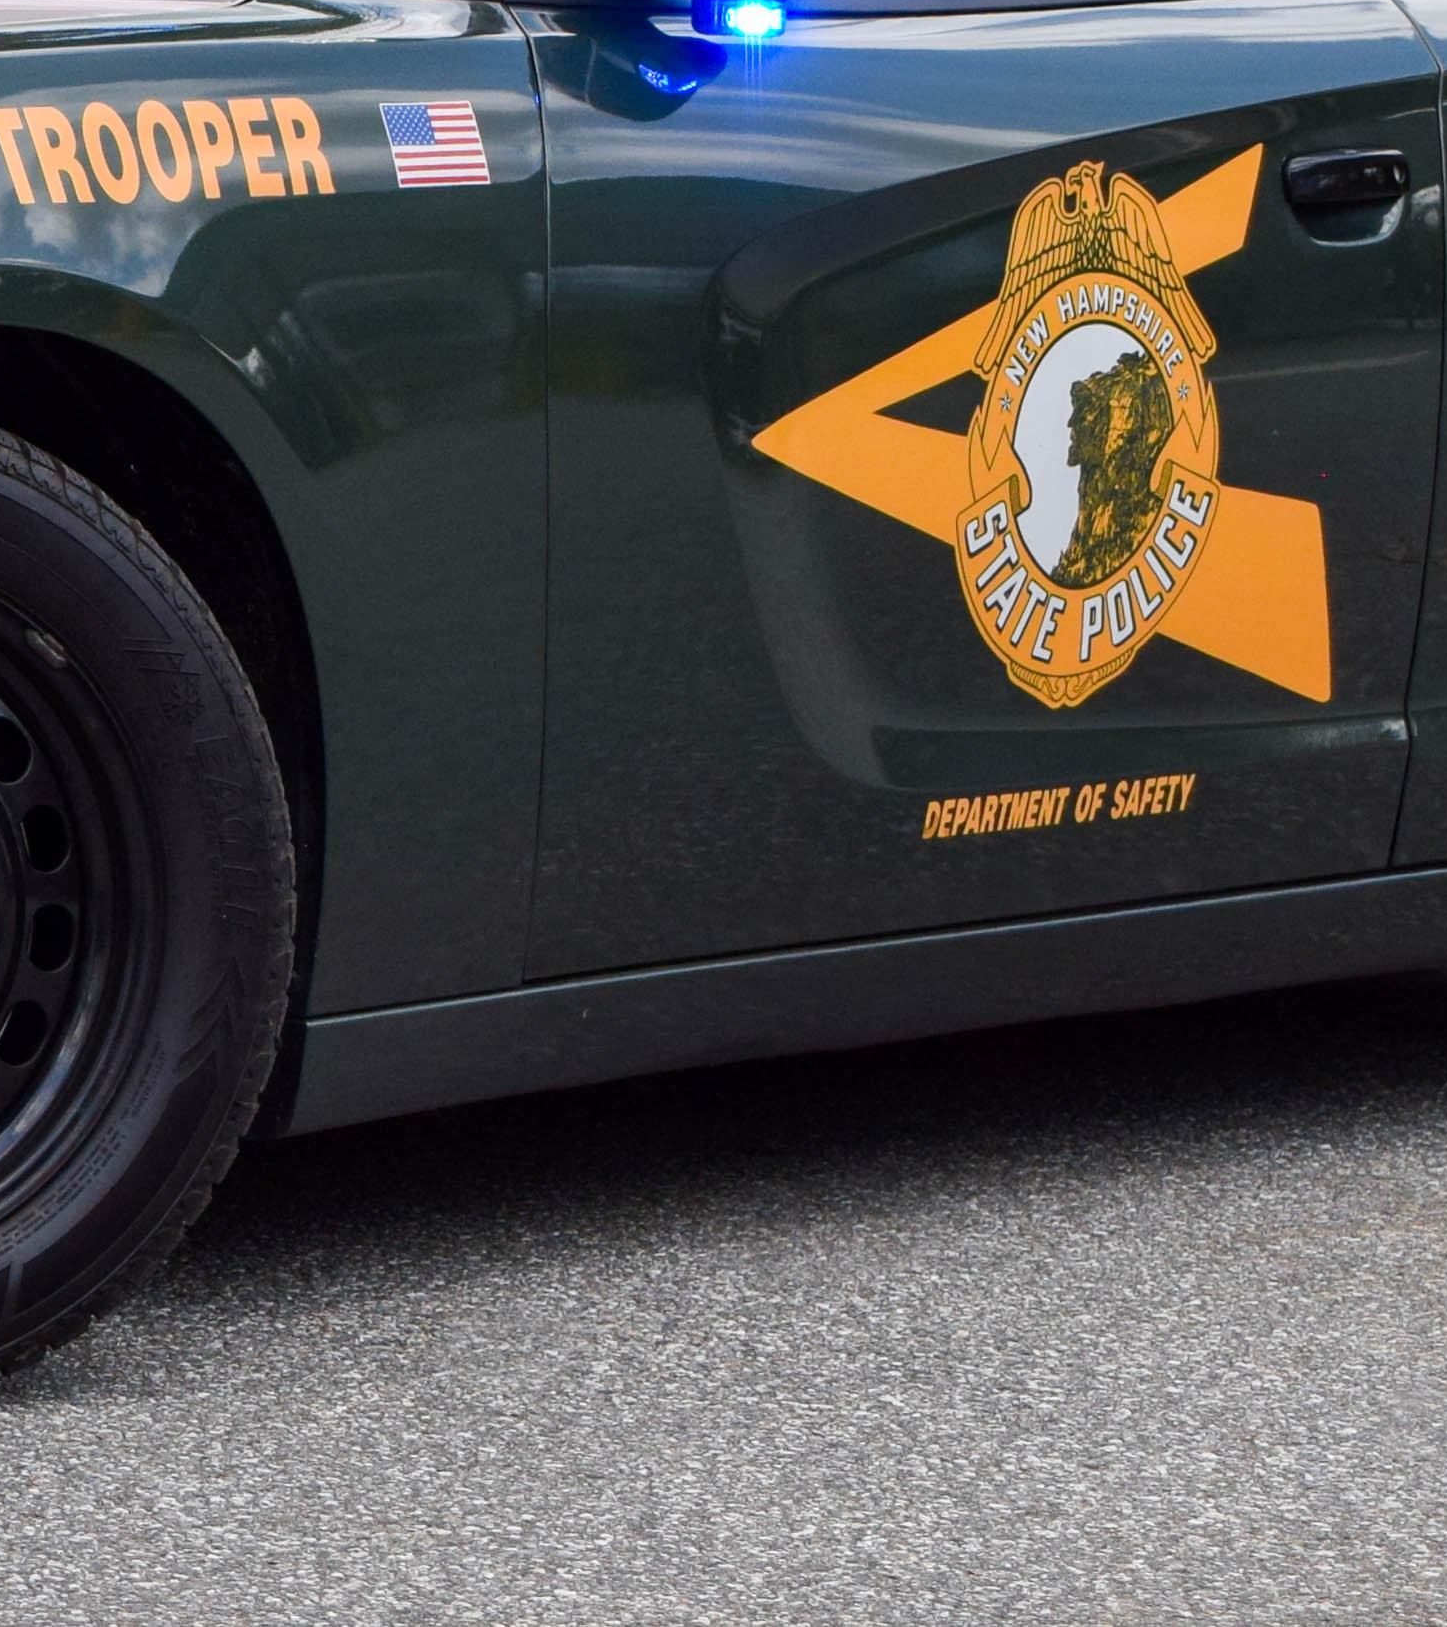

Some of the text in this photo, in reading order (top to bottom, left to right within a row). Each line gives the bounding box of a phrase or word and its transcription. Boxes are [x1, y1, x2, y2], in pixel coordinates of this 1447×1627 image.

[1005, 284, 1183, 386] NEW HAMPSHIRE
[965, 479, 1213, 663] STATE POLICE
[922, 773, 1196, 840] DEPARTMENT OF SAFETY
